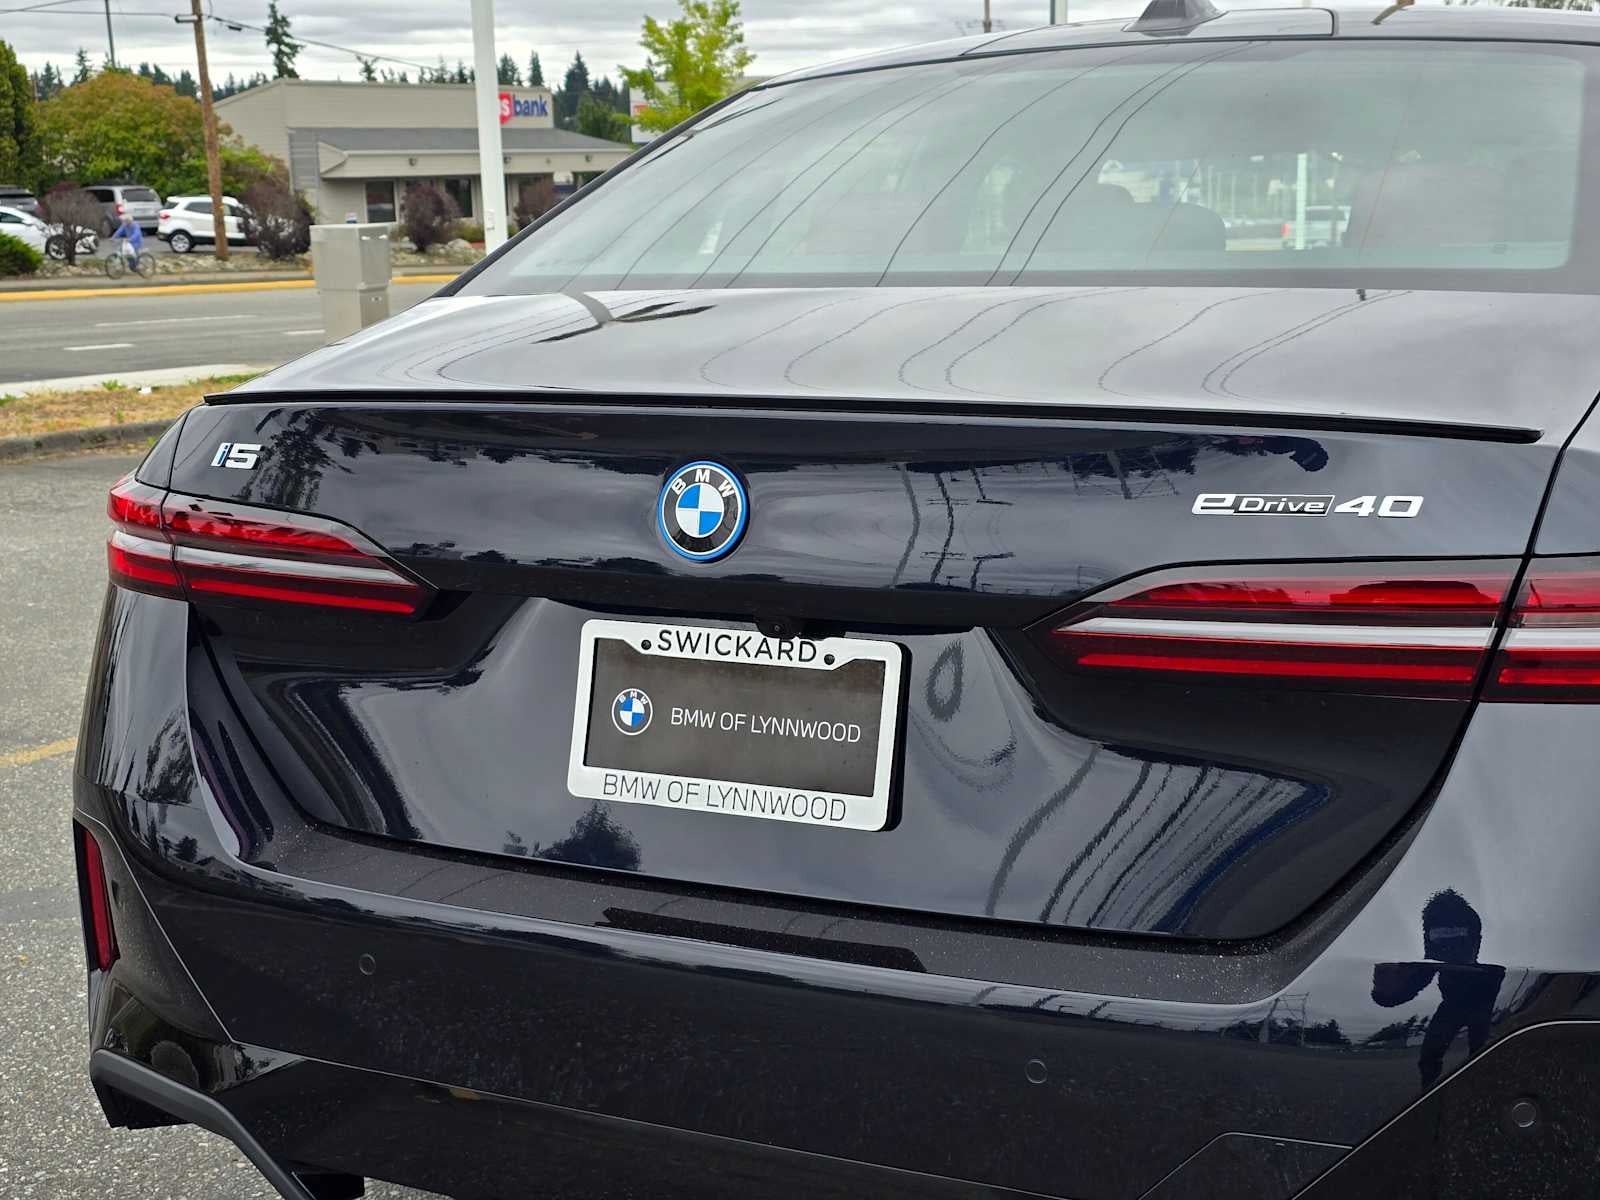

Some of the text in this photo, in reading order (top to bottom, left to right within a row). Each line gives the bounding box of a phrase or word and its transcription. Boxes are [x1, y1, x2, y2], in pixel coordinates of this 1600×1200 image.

[211, 442, 262, 469] i5
[672, 468, 735, 498] BMW
[1334, 495, 1424, 518] 40
[657, 629, 818, 663] SWICKARD
[618, 690, 648, 705] BMW
[671, 707, 861, 743] BMW OF LYNNWOOD
[603, 773, 846, 822] BMW OF LYNNWOOD
